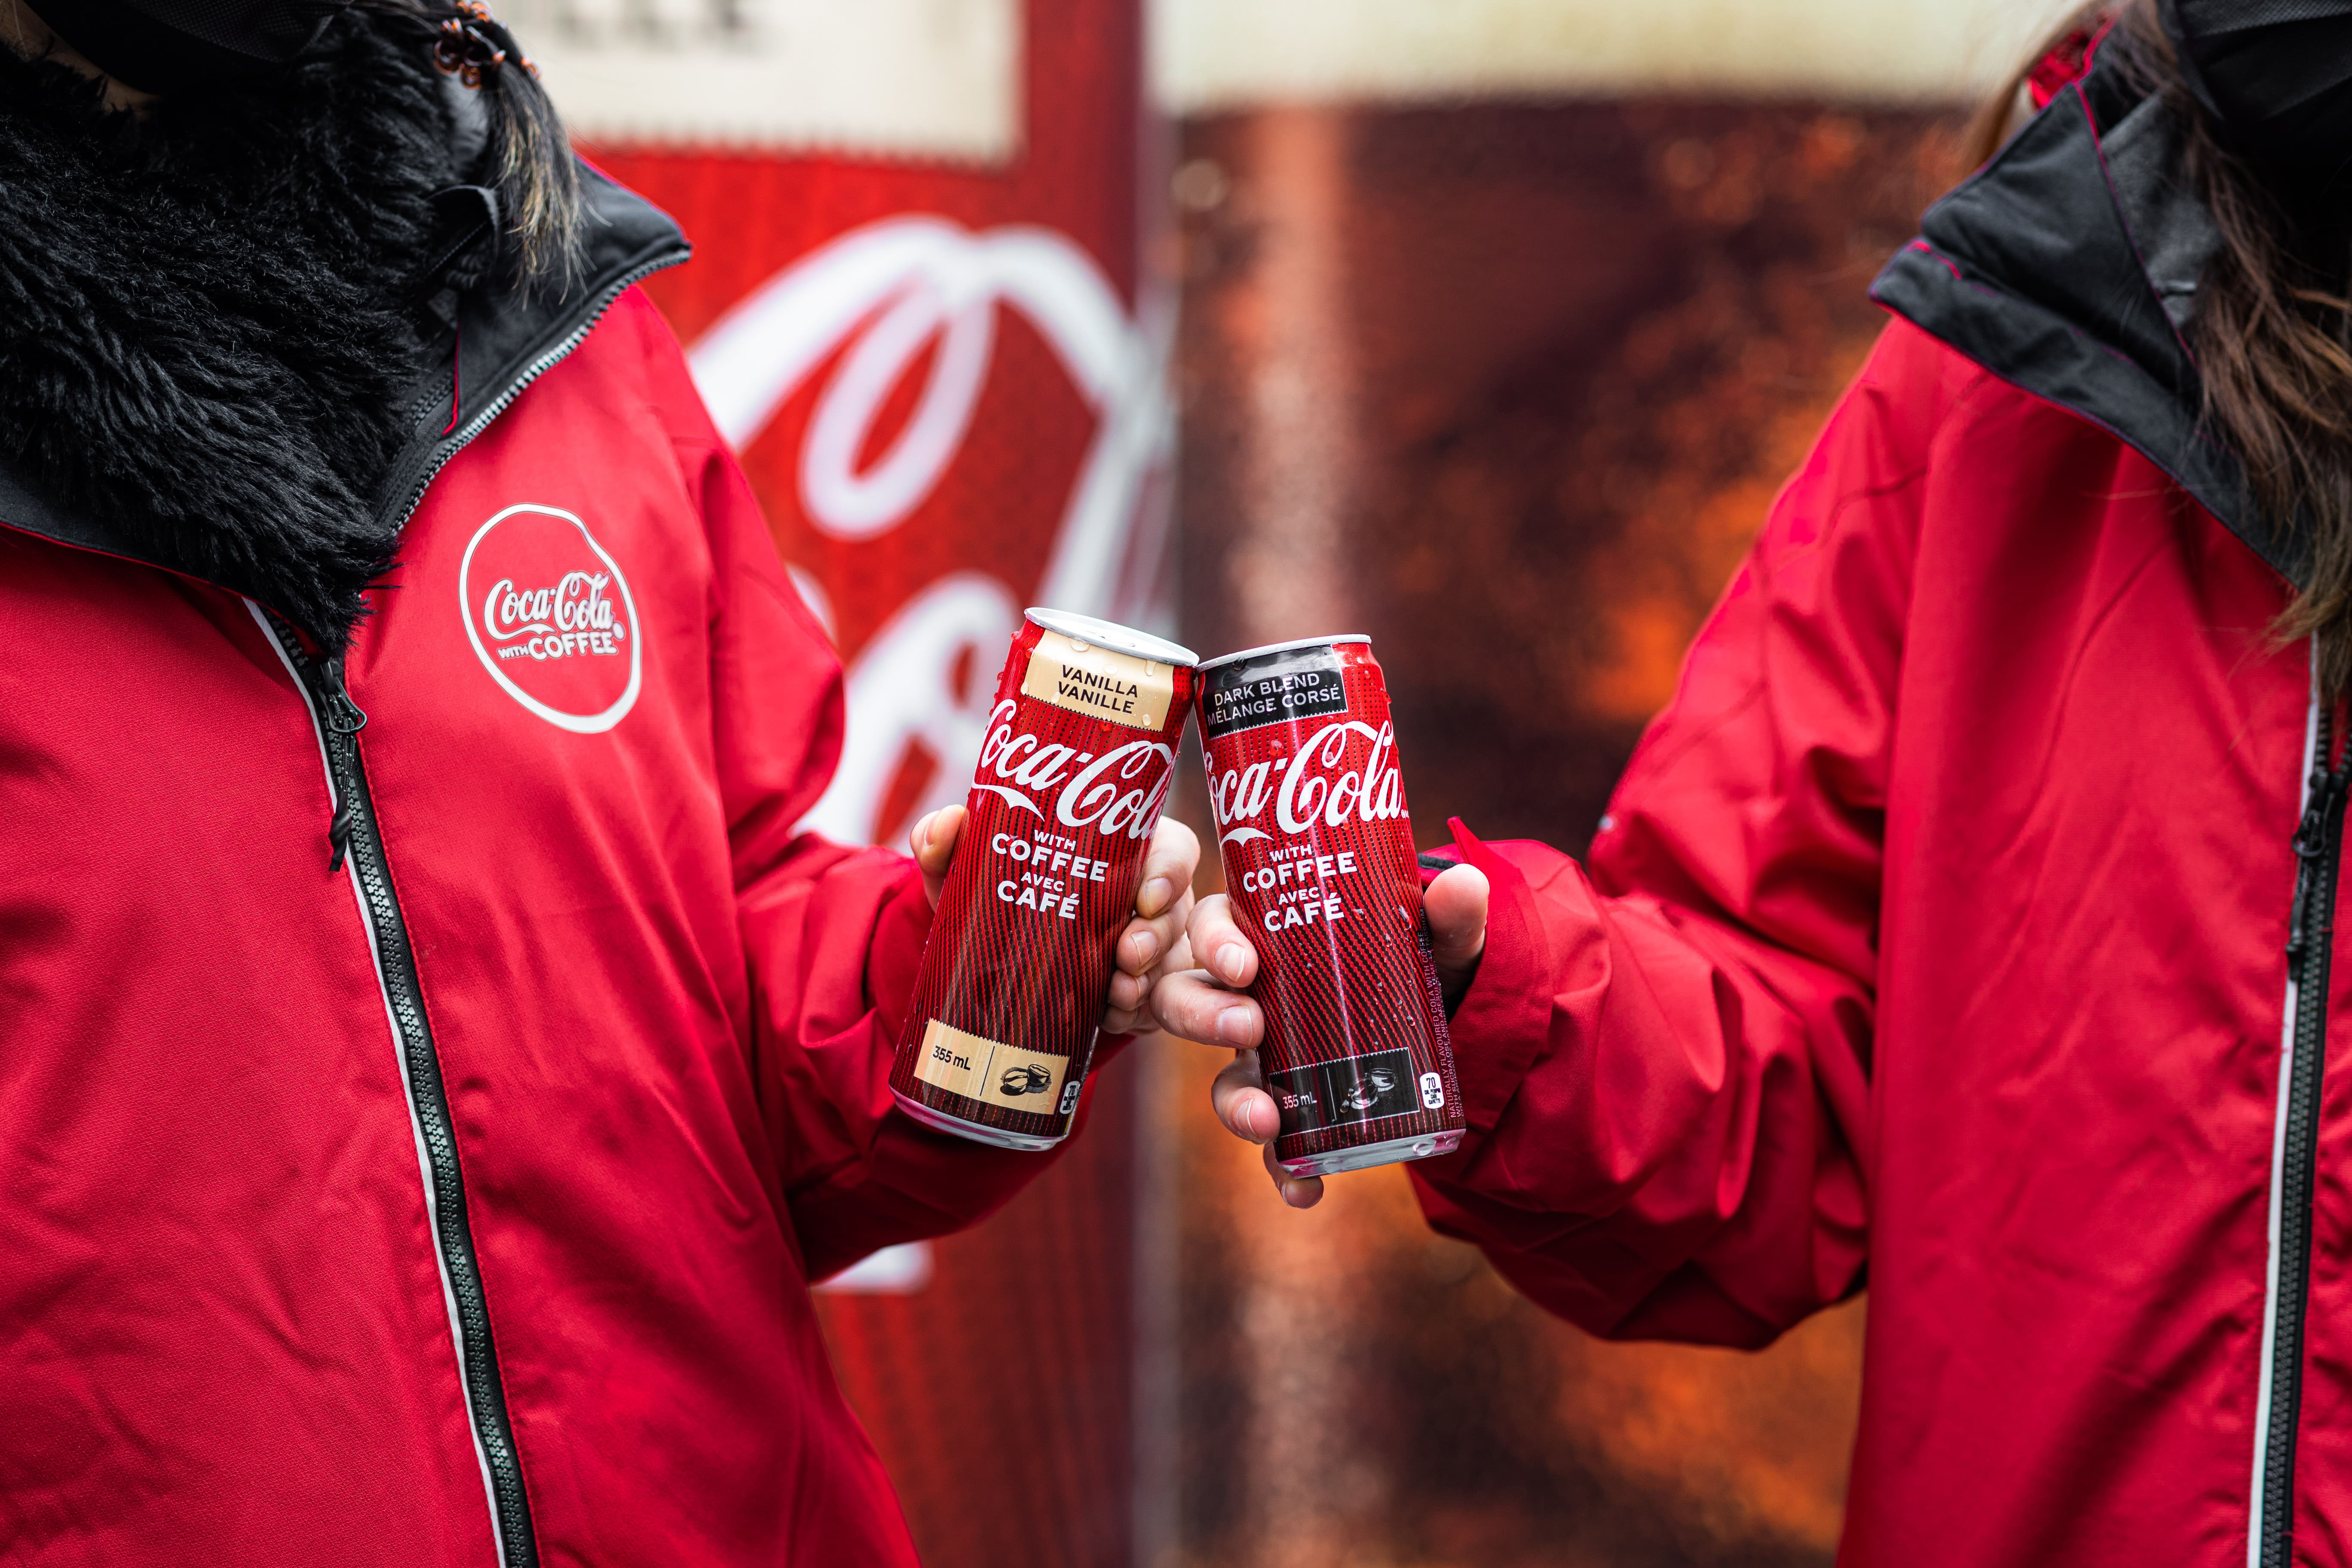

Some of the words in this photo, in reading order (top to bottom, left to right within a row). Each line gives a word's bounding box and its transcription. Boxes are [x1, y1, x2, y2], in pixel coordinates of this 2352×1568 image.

[484, 571, 614, 640] Coca-Cola
[497, 645, 530, 660] WITH
[528, 631, 618, 661] COFFEE
[1058, 681, 1134, 714] VANILLE
[1063, 664, 1138, 698] VANILLA
[1214, 686, 1255, 706] DARK
[1263, 673, 1320, 695] BLEND
[1208, 698, 1277, 726] MÉLANGE
[1282, 684, 1341, 708] CORSÉ
[1034, 829, 1076, 851] WITH
[1270, 844, 1312, 862] WITH
[992, 832, 1109, 882] COFFEE
[1243, 851, 1357, 893] COFFEE
[1021, 871, 1065, 892] AVEC
[1279, 887, 1320, 905] AVEC
[997, 881, 1080, 919] CAFÉ
[1265, 892, 1345, 931] CAFÉ
[1424, 966, 1433, 988] WITH
[1428, 990, 1437, 1013] COLA
[1433, 1016, 1447, 1066] FLAVOURED
[933, 1045, 952, 1063] 355
[952, 1055, 971, 1071] mL
[1443, 1041, 1457, 1092] SUCRALOSE
[1426, 1077, 1436, 1089] 70
[1442, 1069, 1456, 1118] NATURALLY
[1283, 1095, 1298, 1110] 355
[1300, 1091, 1317, 1106] mL
